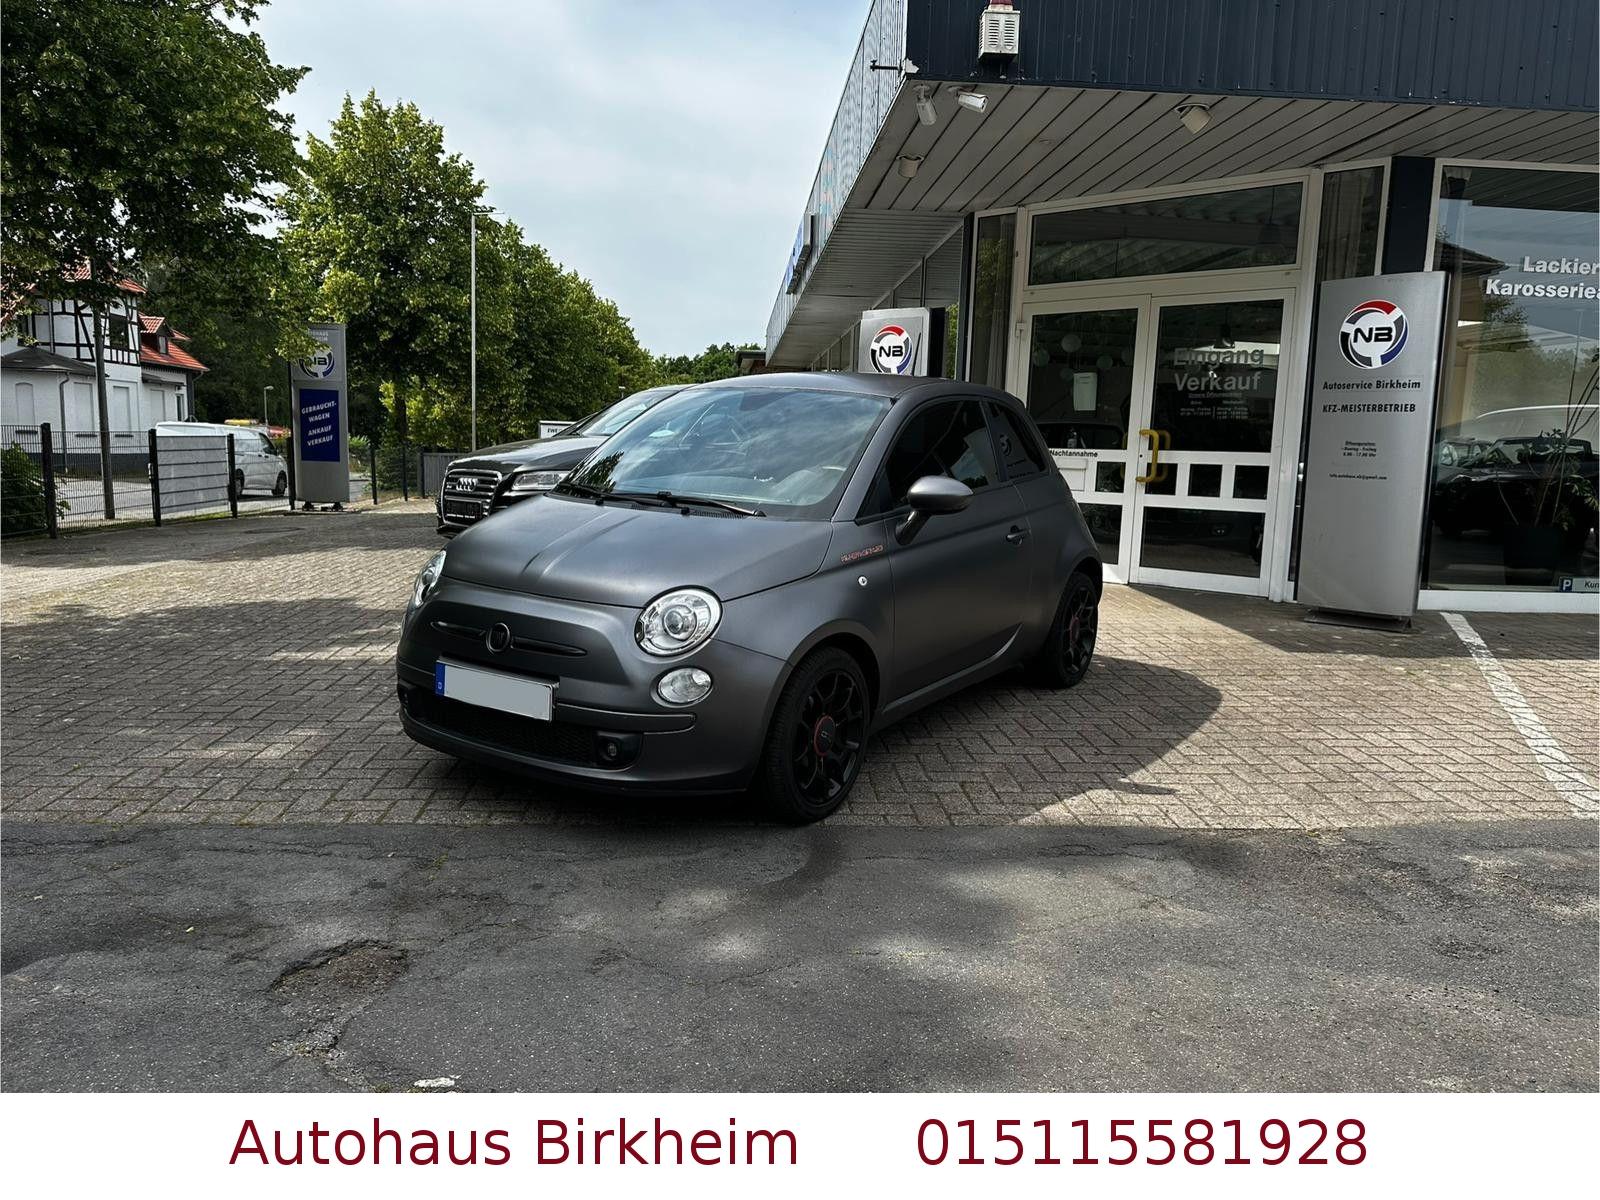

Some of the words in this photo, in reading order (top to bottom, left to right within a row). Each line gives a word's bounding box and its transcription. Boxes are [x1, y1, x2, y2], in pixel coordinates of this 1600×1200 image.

[1353, 326, 1393, 343] NB
[879, 345, 904, 358] NB
[1174, 347, 1265, 369] Eingang
[1174, 371, 1262, 392] Verkauf
[1322, 381, 1373, 390] Autoservice
[1375, 379, 1421, 389] Birkheim
[1322, 403, 1416, 413] KFZ-MEISTERBETRIEB
[309, 412, 330, 422] WAGEN
[308, 425, 332, 435] ANKAUF
[307, 435, 333, 446] VERKAUF
[1049, 449, 1098, 458] Nachtannahme
